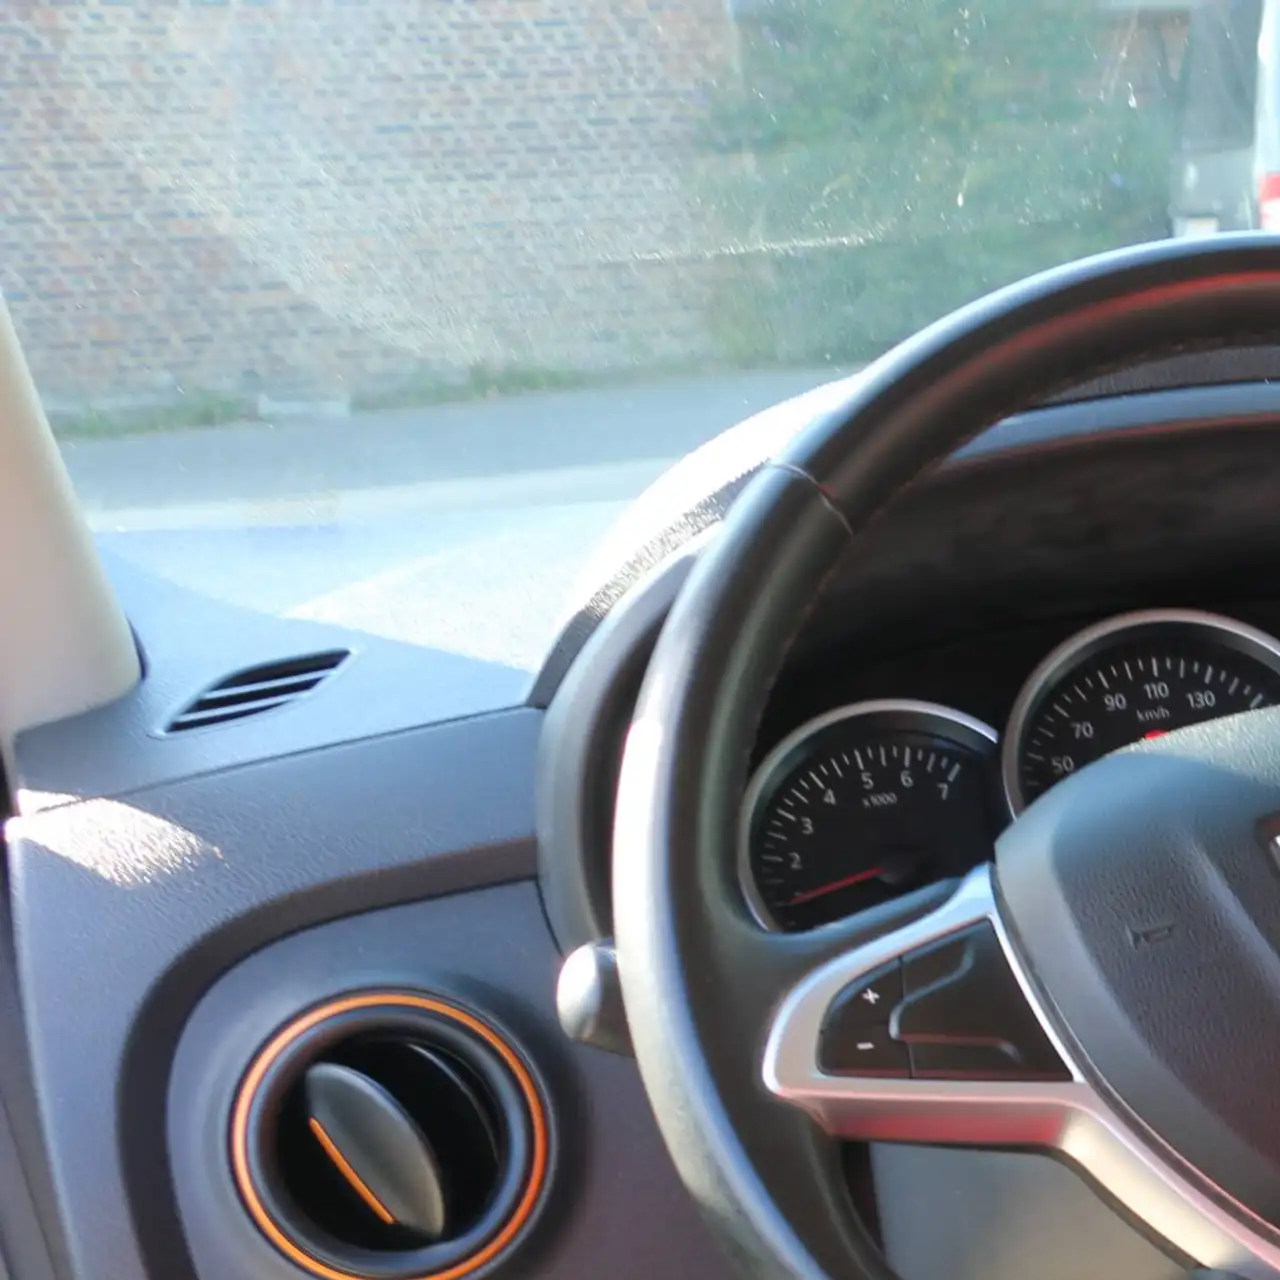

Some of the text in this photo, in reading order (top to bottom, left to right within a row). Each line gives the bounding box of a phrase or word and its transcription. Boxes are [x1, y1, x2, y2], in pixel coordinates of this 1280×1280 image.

[1144, 681, 1170, 700] 110
[1186, 689, 1216, 709] 130
[1103, 692, 1127, 712] 90
[1136, 706, 1171, 722] km/h
[1070, 721, 1094, 740] 70
[1052, 755, 1075, 775] 50
[862, 771, 875, 790] 5
[900, 769, 914, 788] 6
[823, 788, 837, 806] 4
[937, 782, 949, 801] 7
[801, 817, 814, 836] 3
[788, 851, 802, 870] 2
